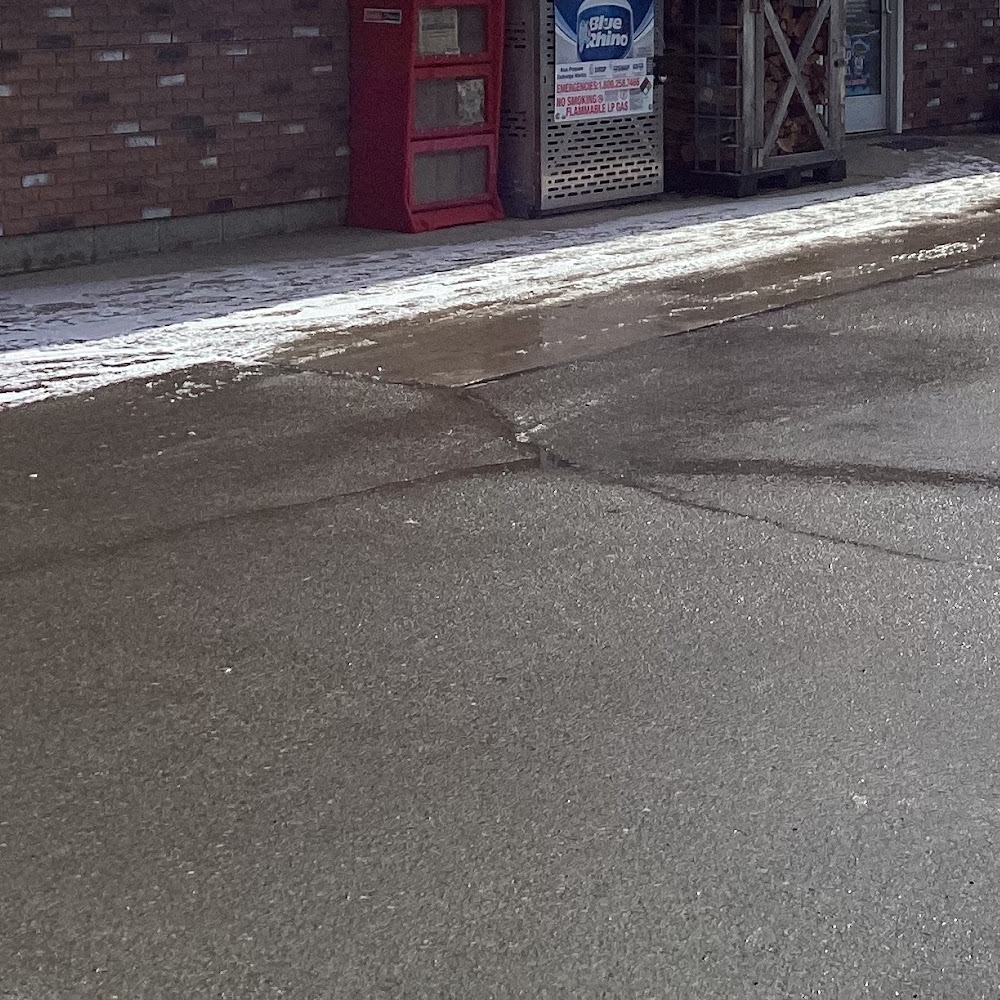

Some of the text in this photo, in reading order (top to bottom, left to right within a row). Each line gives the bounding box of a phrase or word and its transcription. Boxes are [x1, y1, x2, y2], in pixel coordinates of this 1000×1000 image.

[589, 15, 622, 31] Blue
[586, 30, 628, 49] Rhino
[557, 97, 566, 107] NO
[567, 94, 597, 106] SMOKING
[566, 101, 629, 117] FLAMMABLE LP GAS
